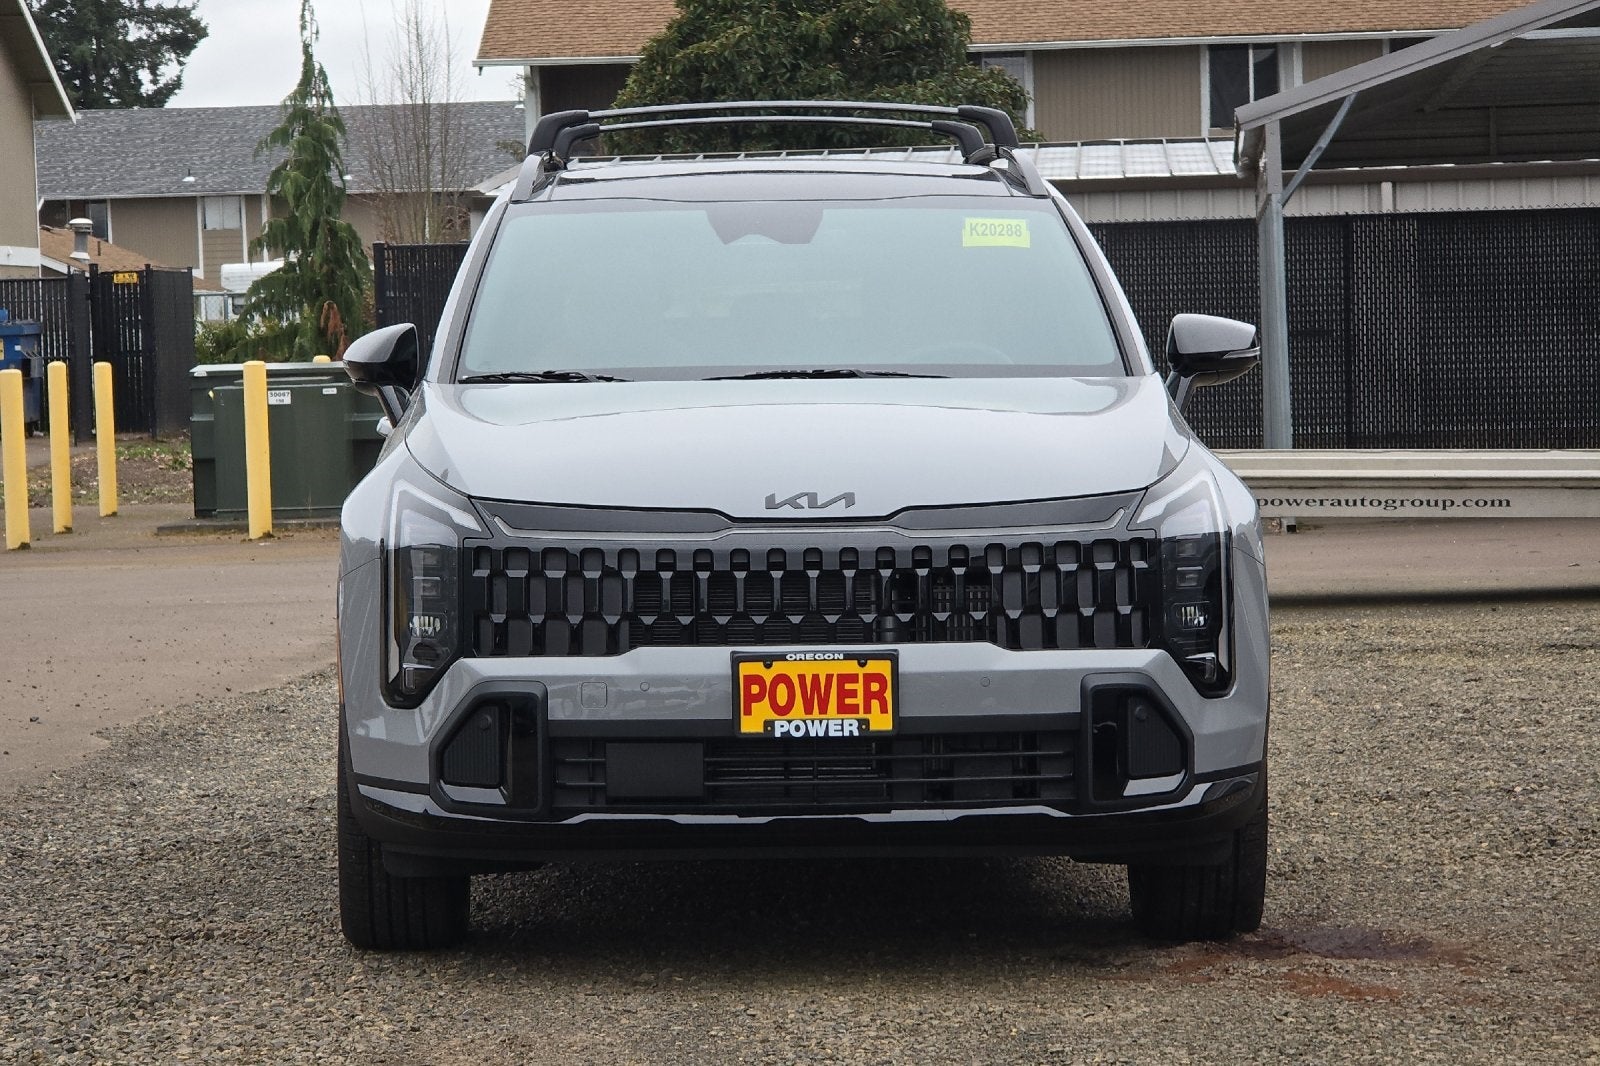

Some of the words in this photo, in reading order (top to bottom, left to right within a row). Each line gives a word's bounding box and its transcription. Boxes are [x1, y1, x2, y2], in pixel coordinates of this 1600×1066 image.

[969, 222, 1023, 238] K20288
[1256, 495, 1512, 511] powerautogroup.com
[785, 652, 844, 661] OREGON
[742, 672, 889, 717] POWER
[774, 718, 860, 738] POWER
